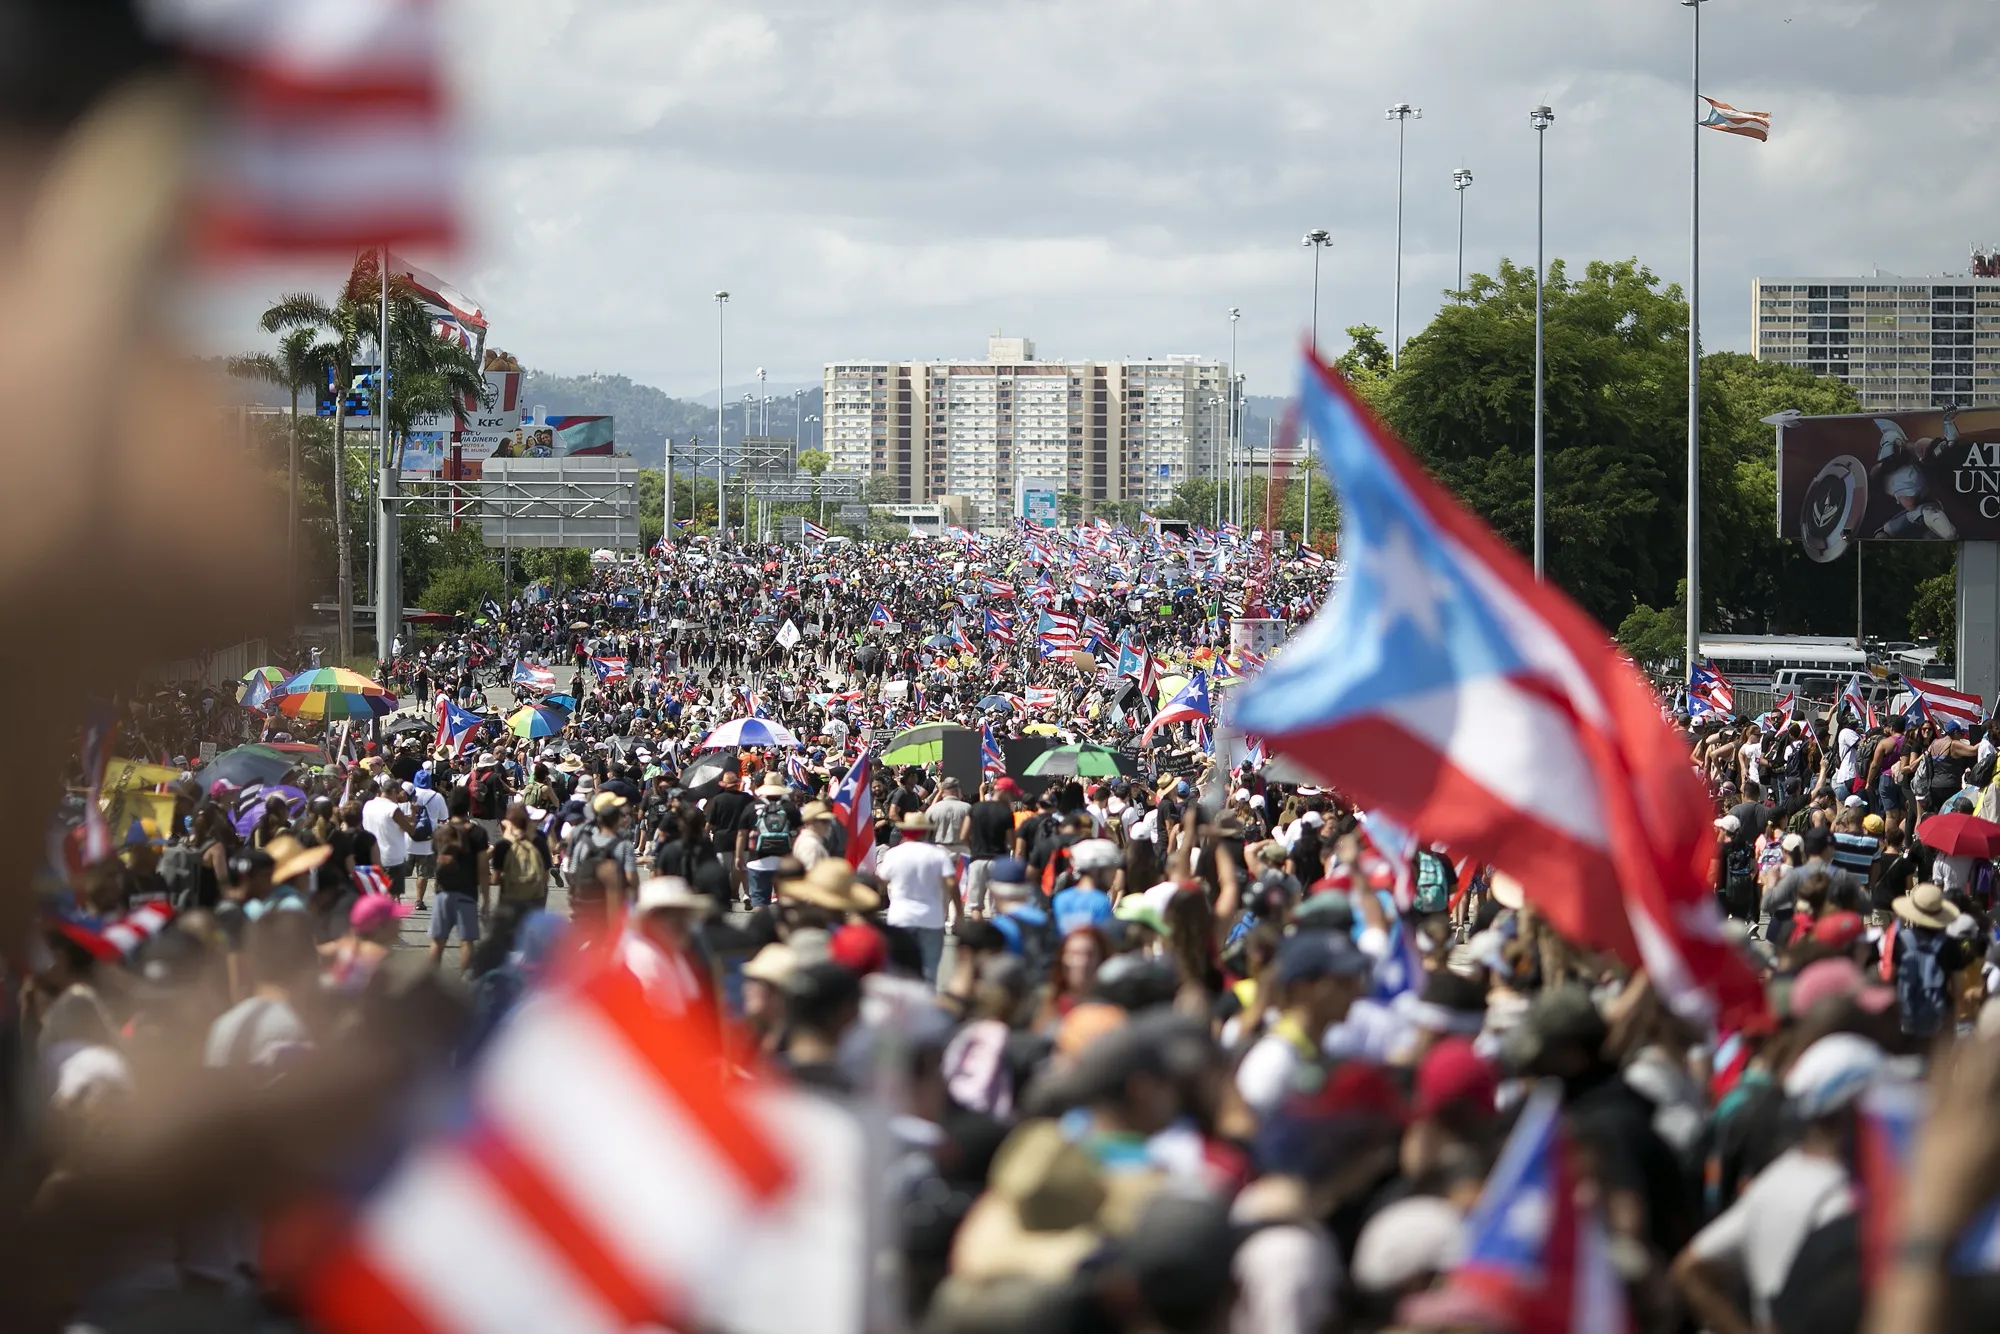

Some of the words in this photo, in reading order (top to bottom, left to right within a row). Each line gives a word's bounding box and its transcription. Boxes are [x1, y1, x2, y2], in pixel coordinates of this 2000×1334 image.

[477, 418, 504, 427] KFC
[398, 438, 435, 454] arty
[1962, 442, 2000, 467] AT
[1953, 470, 2000, 493] UN
[1979, 495, 2000, 518] C
